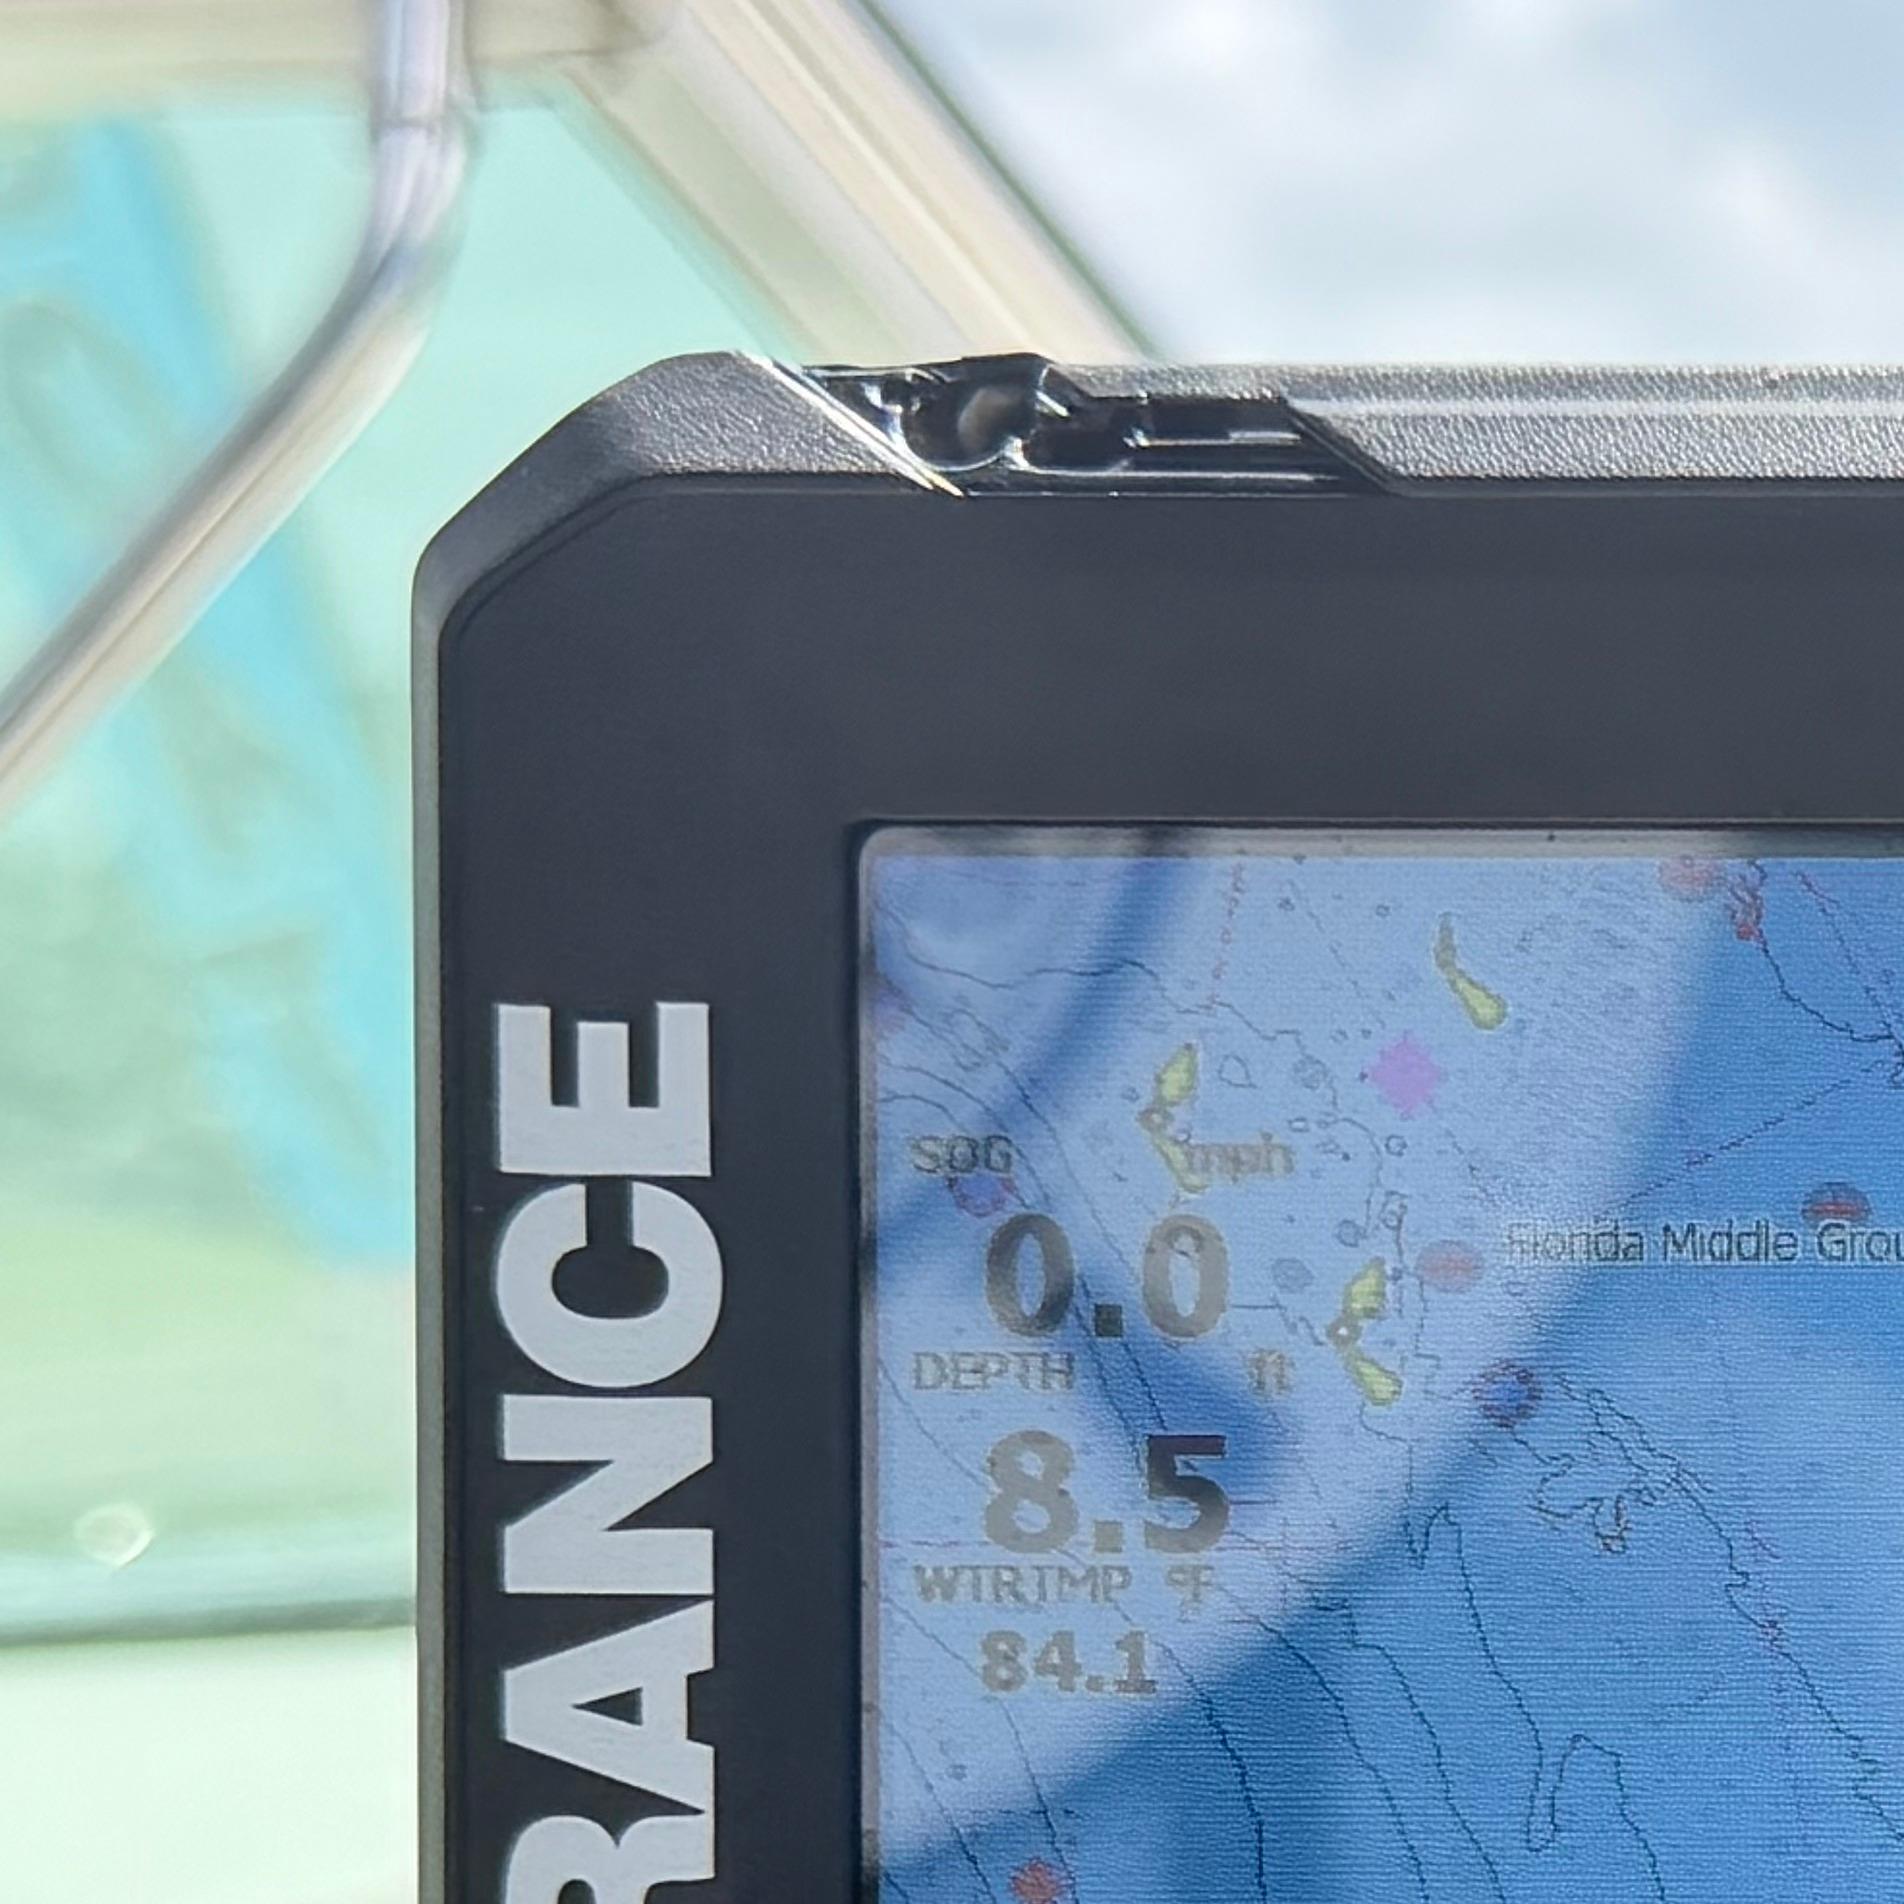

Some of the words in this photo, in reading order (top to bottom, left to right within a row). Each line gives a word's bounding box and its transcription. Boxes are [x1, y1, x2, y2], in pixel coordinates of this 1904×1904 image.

[912, 1136, 1014, 1174] SOG
[1664, 1222, 1798, 1262] Middle
[985, 1213, 1230, 1338] 0.0
[912, 1352, 1075, 1391] DEPTH
[984, 1430, 1230, 1553] 8.5
[980, 1630, 1158, 1692] 84.1
